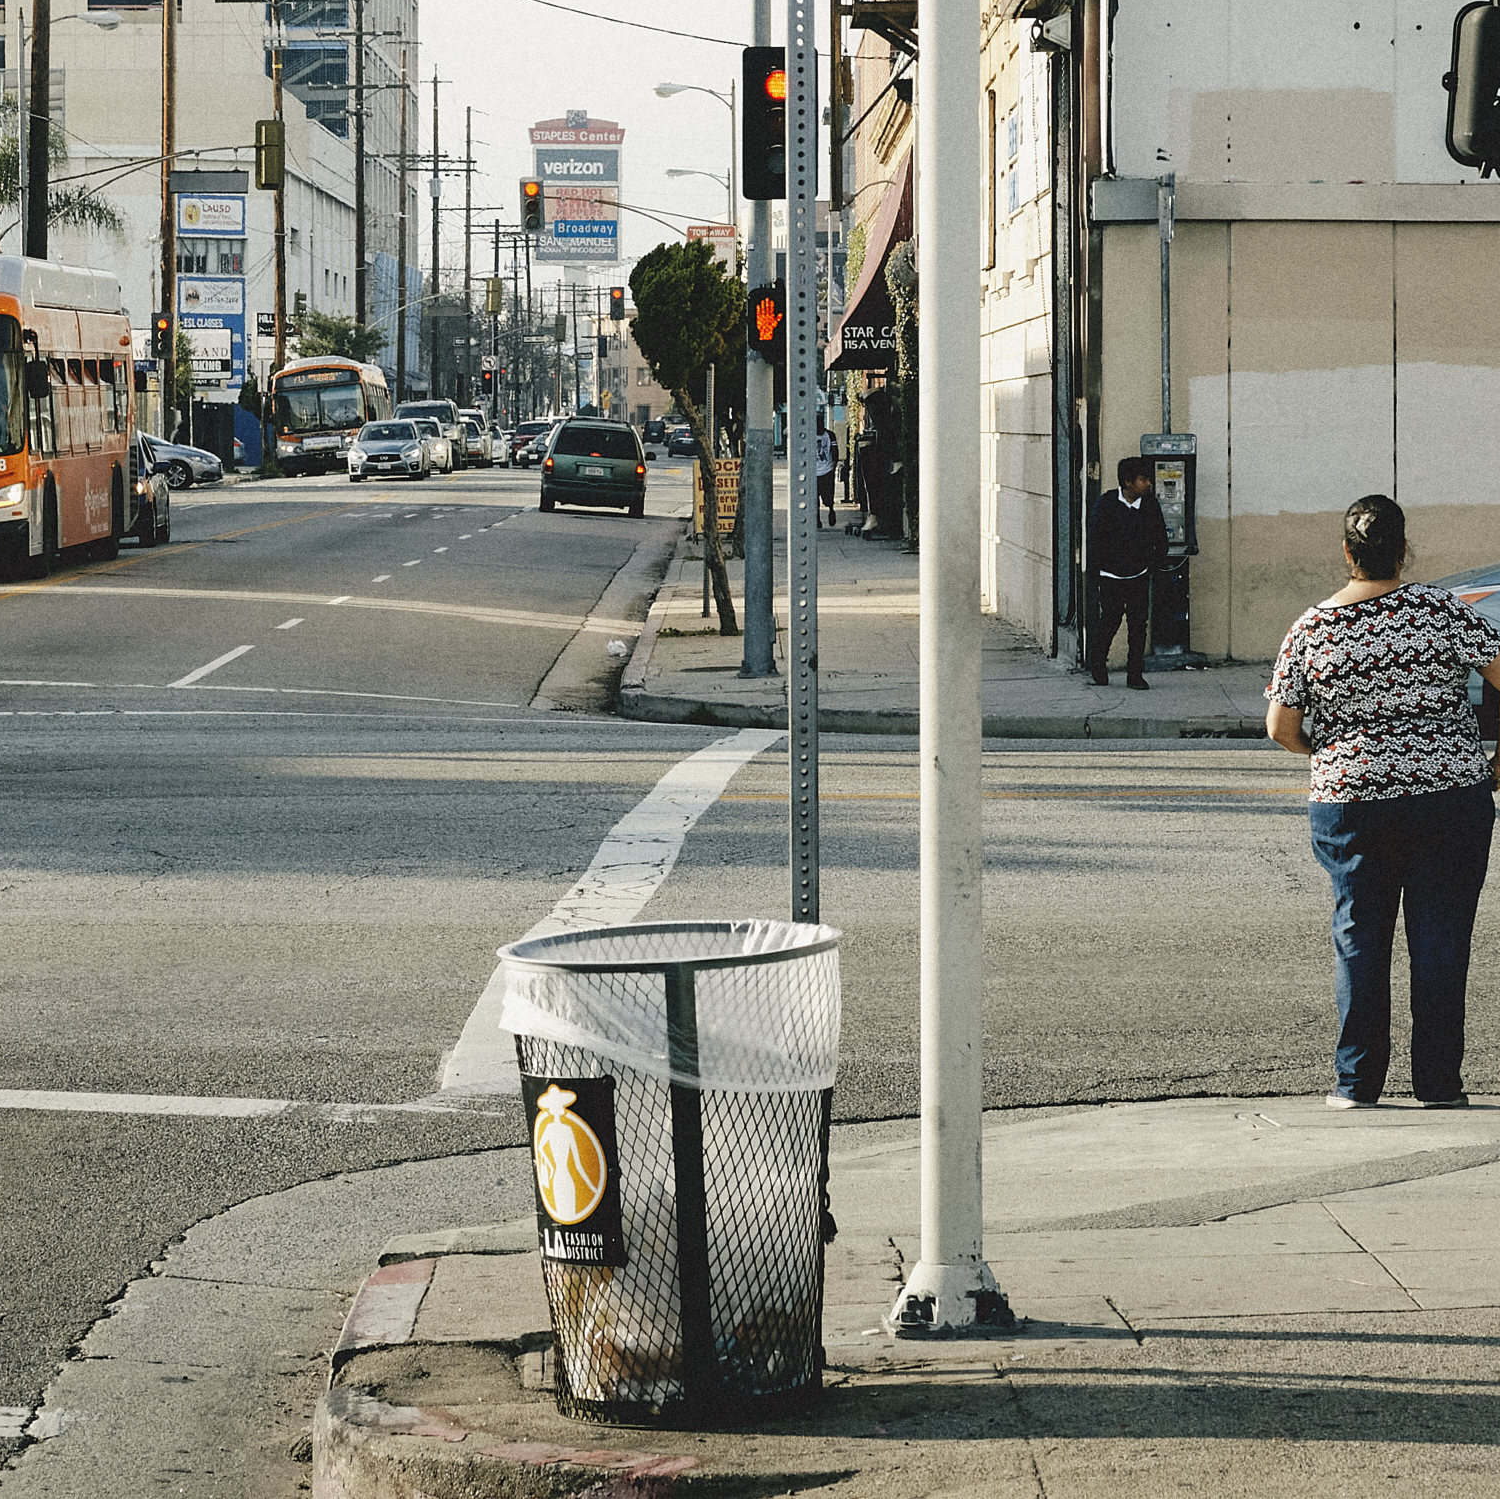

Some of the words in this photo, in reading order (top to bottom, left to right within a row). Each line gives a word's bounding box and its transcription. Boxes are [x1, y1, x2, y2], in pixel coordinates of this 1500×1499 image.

[532, 131, 576, 142] STAPLES
[578, 131, 623, 142] Center
[543, 158, 605, 175] verizon
[556, 188, 579, 196] RED
[581, 188, 604, 196] HOT
[202, 204, 232, 214] LAUSD
[557, 222, 614, 235] Broadway
[843, 326, 875, 338] STAR
[544, 1227, 567, 1259] LA
[564, 1231, 604, 1247] FASHION
[566, 1245, 604, 1261] DISTRICT
